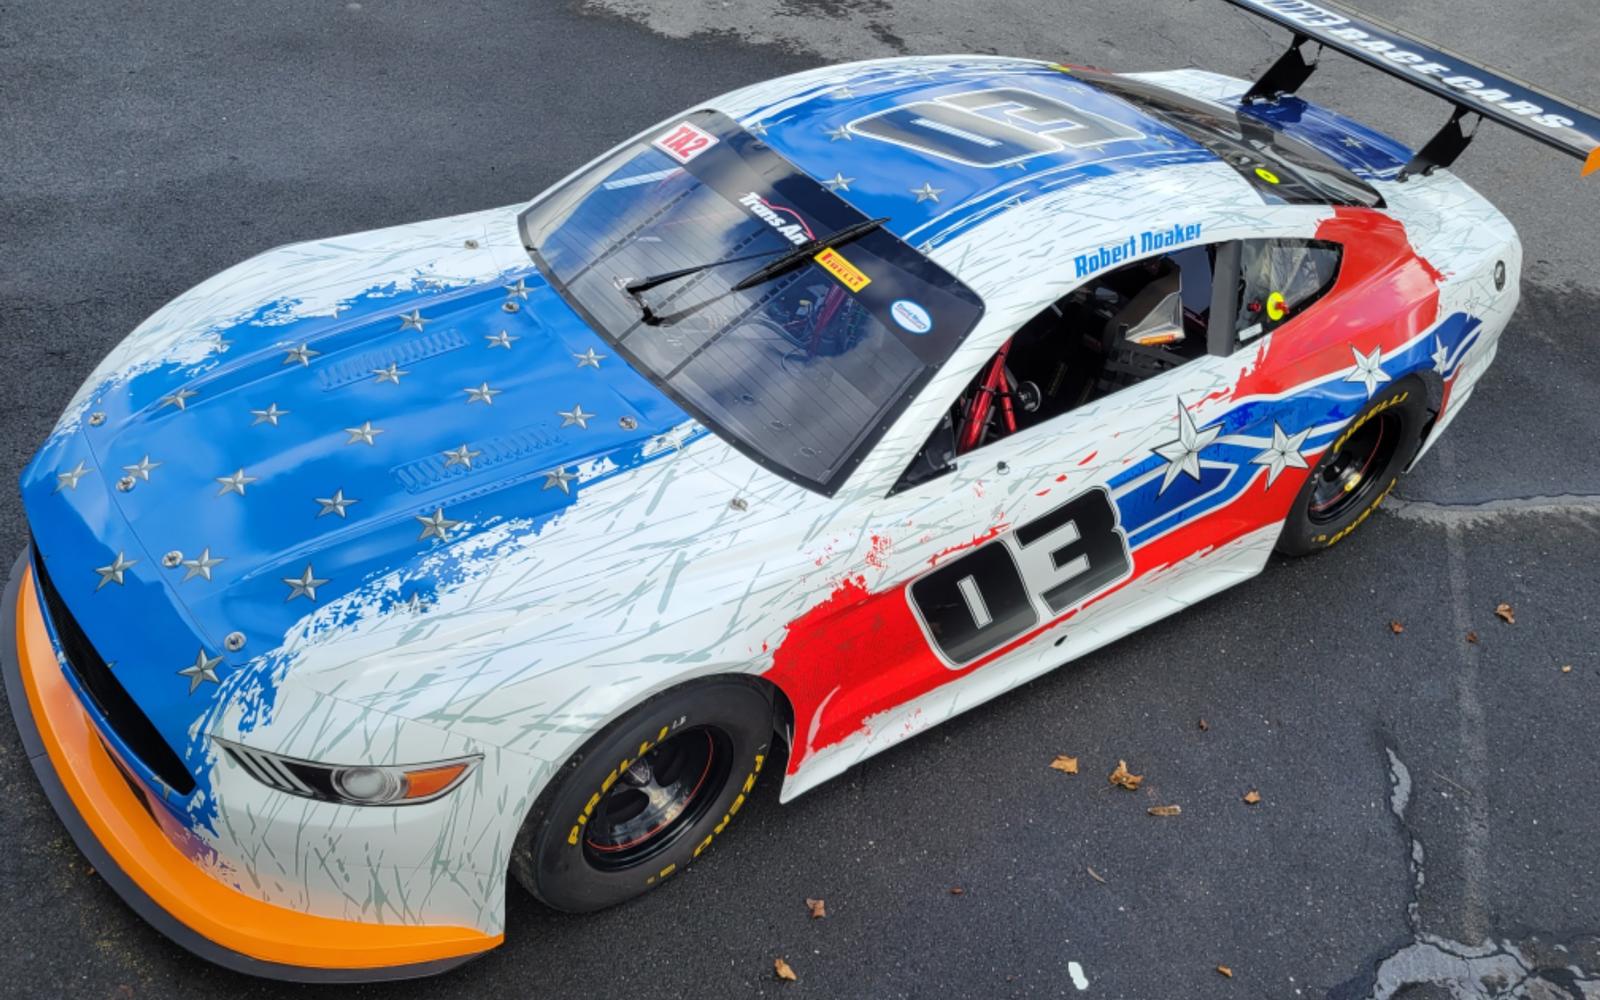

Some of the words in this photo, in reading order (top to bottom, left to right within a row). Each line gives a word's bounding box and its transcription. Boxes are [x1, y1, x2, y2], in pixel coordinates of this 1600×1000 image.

[1327, 27, 1450, 75] RACE
[1442, 75, 1575, 128] CARS
[661, 127, 708, 158] TA2
[739, 191, 786, 227] Trans
[821, 251, 865, 287] PIRELLI
[1074, 235, 1136, 279] Robert
[1140, 223, 1202, 254] Noaker
[1333, 391, 1408, 454] PIRELLI
[906, 486, 1134, 669] 03
[567, 725, 670, 846] PIRELLI
